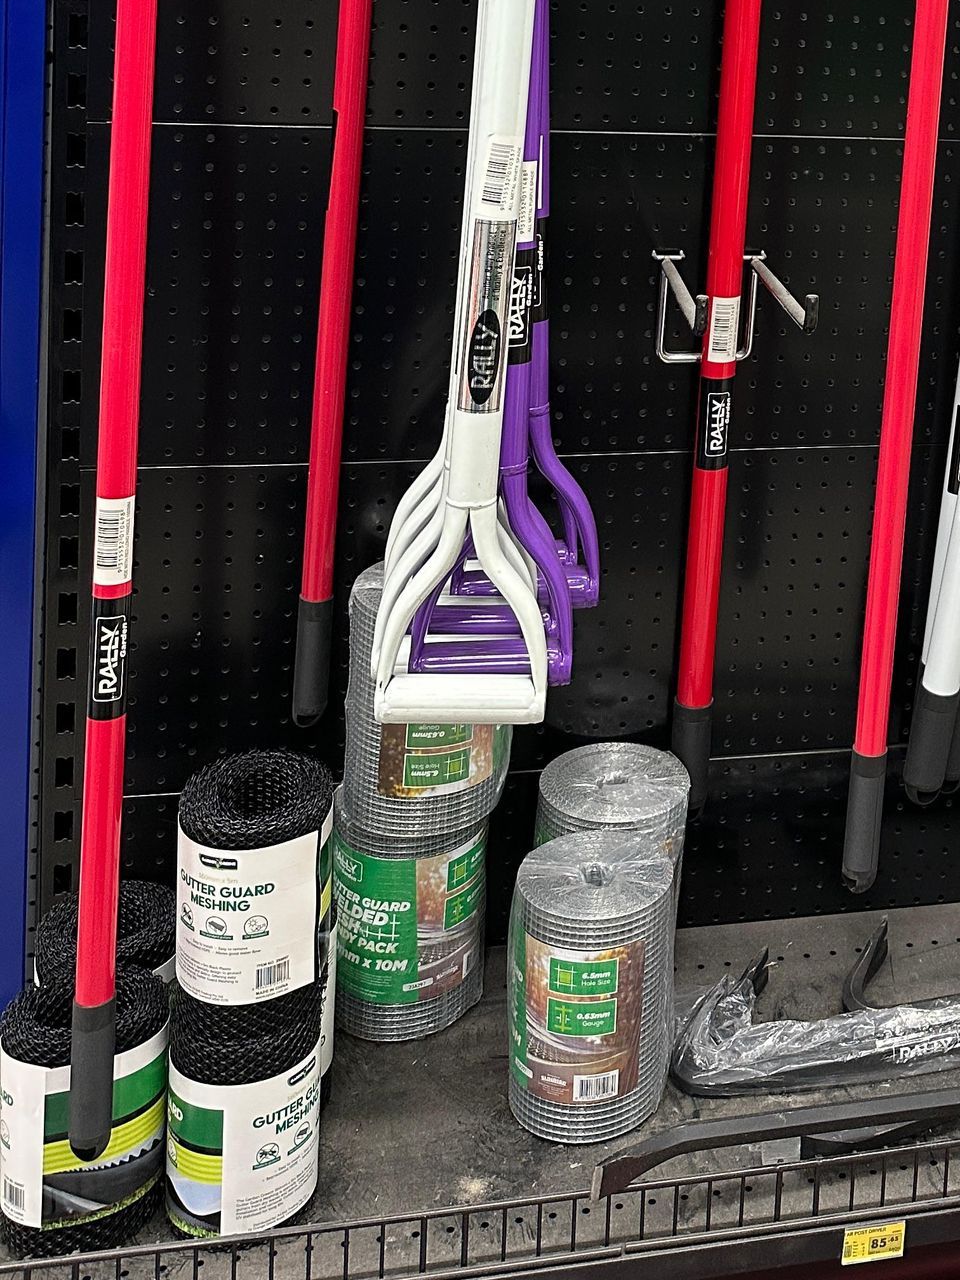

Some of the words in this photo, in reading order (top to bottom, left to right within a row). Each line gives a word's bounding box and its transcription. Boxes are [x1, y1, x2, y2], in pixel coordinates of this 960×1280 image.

[509, 276, 527, 340] RALLY
[471, 323, 499, 390] RALLY
[710, 398, 726, 452] RALLY
[120, 622, 128, 658] Garden
[98, 623, 120, 694] RALLY
[412, 730, 446, 738] 0.63mm
[410, 770, 438, 778] 6.5mm
[180, 868, 216, 896] GUTTER
[220, 882, 275, 899] GUARD
[190, 891, 251, 912] MESHING
[362, 896, 411, 912] GUARD
[358, 938, 399, 954] PACK
[362, 959, 371, 969] x
[374, 959, 408, 972] 10M
[581, 979, 596, 987] Hole
[597, 978, 611, 986] Size
[582, 972, 612, 980] 6.5mm
[576, 1012, 611, 1021] 0.63mm
[582, 1019, 604, 1028] Gauge
[252, 1096, 304, 1130] GUTTER
[275, 1088, 320, 1135] MESHING
